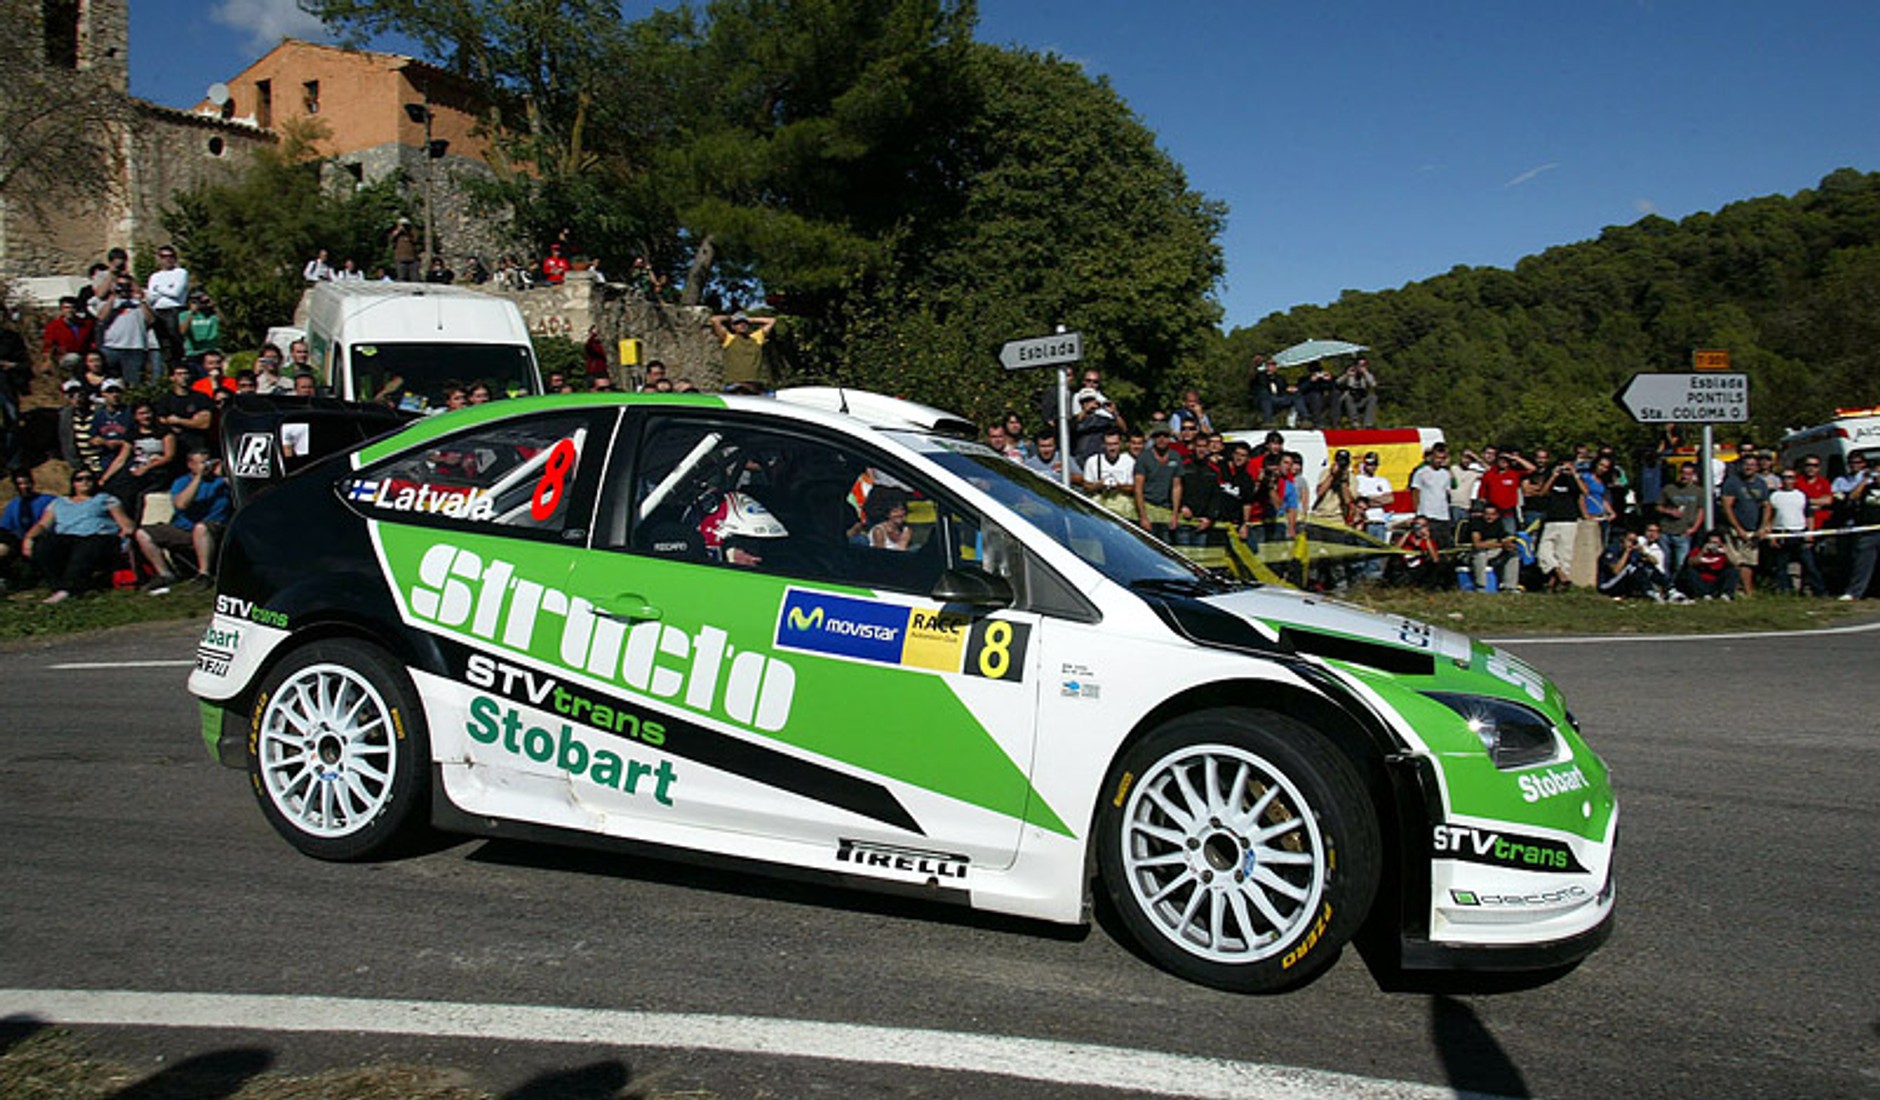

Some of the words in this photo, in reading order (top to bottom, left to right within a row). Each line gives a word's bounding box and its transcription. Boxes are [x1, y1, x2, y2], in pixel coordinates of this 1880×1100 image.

[1019, 341, 1075, 361] Esblada
[1687, 392, 1744, 404] PONTILS
[1690, 376, 1743, 389] Esblada
[1672, 406, 1726, 419] COLOMA
[375, 477, 498, 521] Latvala
[531, 438, 575, 521] 8
[825, 617, 899, 642] movistar
[979, 620, 1013, 679] 8
[465, 653, 667, 746] STVtrans
[466, 696, 677, 806] Stobart
[1518, 765, 1590, 802] Stobart
[836, 837, 971, 878] PIRELLI
[1433, 825, 1568, 868] STVtrans
